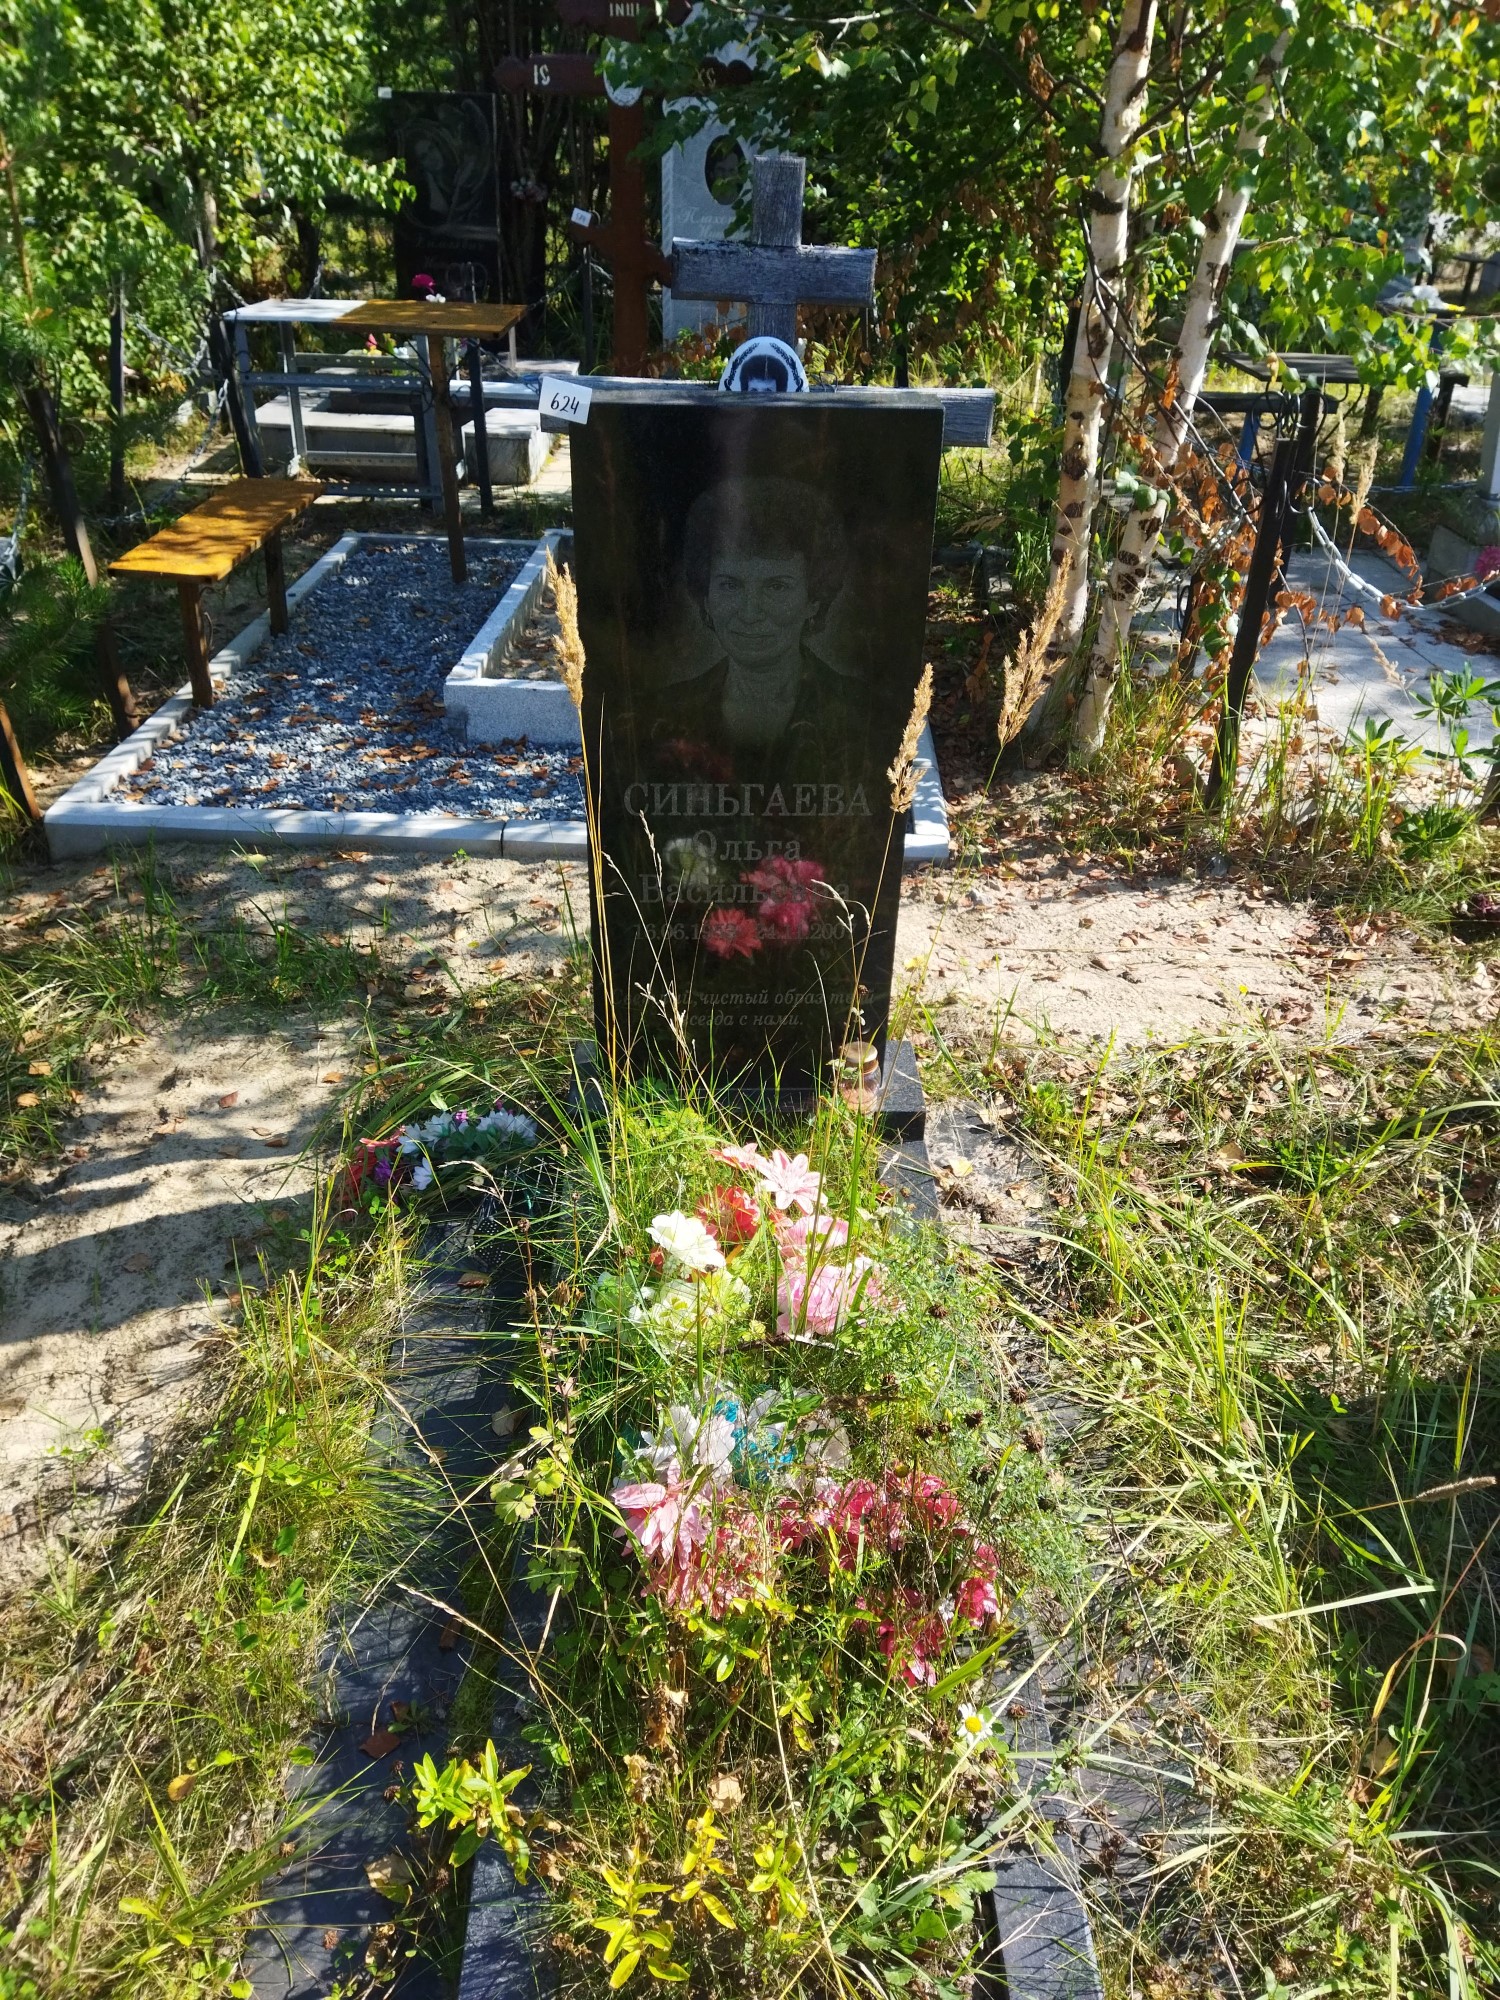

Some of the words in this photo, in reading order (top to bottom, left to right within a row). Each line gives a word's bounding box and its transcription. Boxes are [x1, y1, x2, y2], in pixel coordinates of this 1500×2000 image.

[533, 64, 551, 86] IS
[550, 392, 580, 415] 624
[622, 782, 874, 817] СИНЬГАЕВА
[692, 829, 801, 861] Ольга
[774, 987, 826, 1008] образ
[739, 1014, 748, 1026] с
[753, 1013, 804, 1026] нами.
